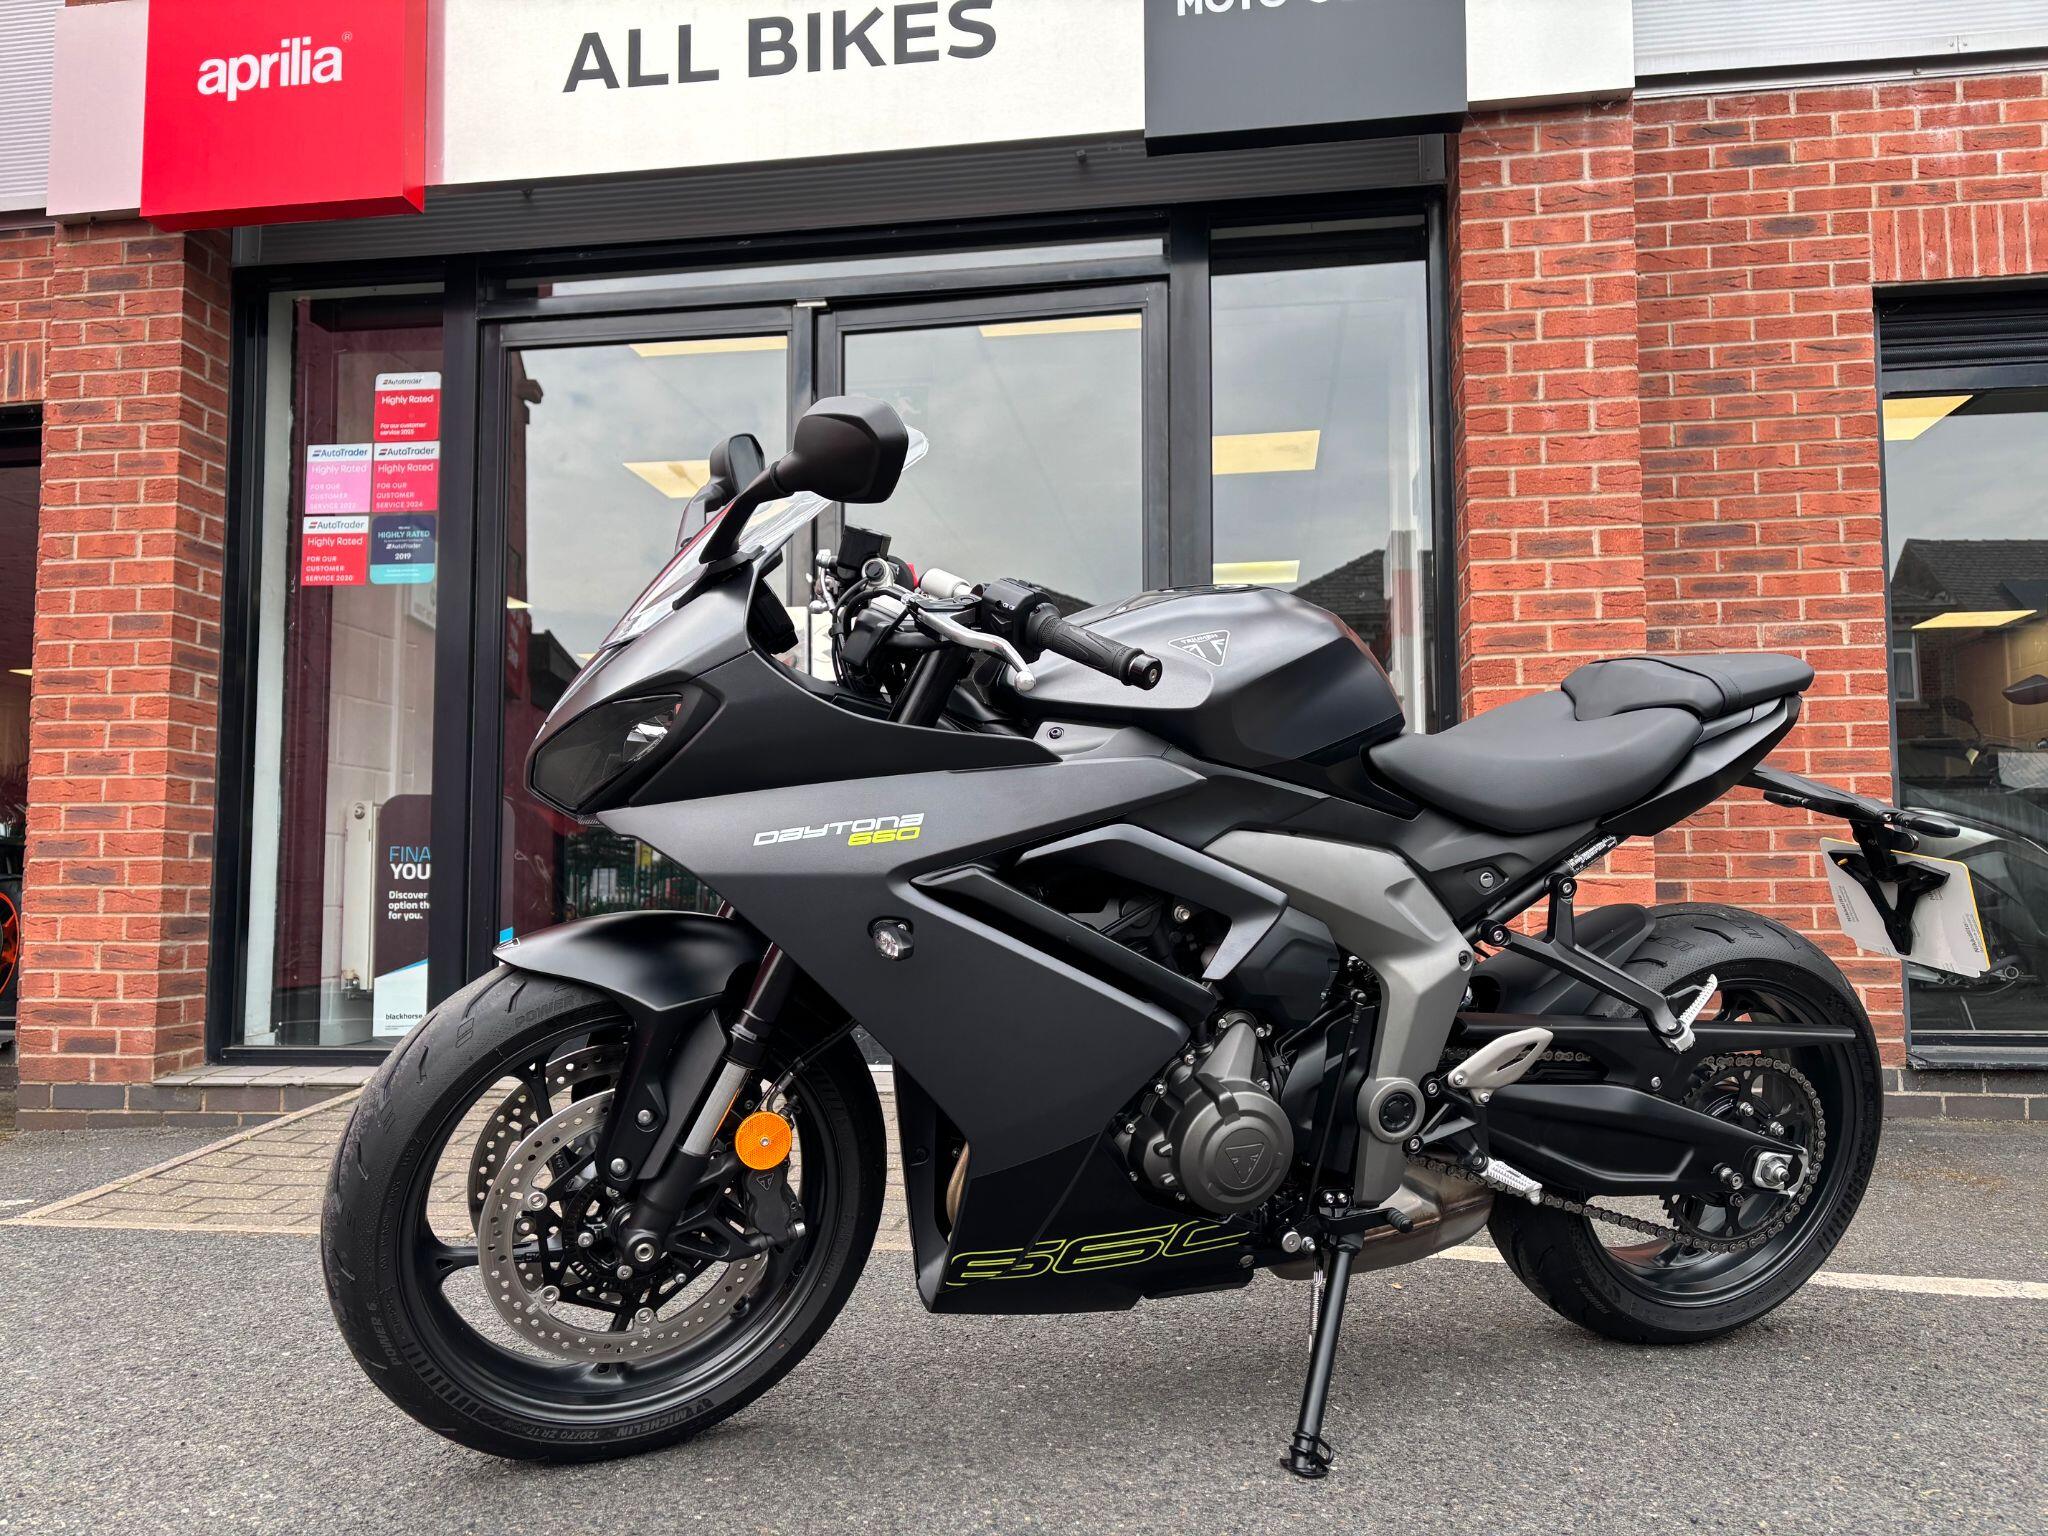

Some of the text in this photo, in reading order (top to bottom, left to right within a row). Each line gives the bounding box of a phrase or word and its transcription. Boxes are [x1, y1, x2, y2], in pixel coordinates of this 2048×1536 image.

[562, 0, 997, 93] ALL BIKES
[197, 36, 343, 102] aprilia
[381, 393, 434, 406] Highly Rated
[320, 448, 368, 457] AutoTrader
[387, 446, 435, 456] AutoTrader
[378, 462, 434, 475] Highly Rated
[392, 481, 408, 489] OUR
[376, 491, 415, 499] CUSTOMER
[317, 520, 365, 530] AutoTrader
[377, 529, 430, 539] HIGHLY RATED
[307, 535, 363, 547] Highly Rated
[321, 555, 337, 563] OUR
[394, 552, 412, 560] 2019
[305, 564, 345, 572] CUSTOMER
[305, 574, 334, 582] SERVICE
[848, 826, 921, 847] 660
[389, 846, 431, 862] FINA
[389, 863, 431, 880] YOU
[388, 890, 428, 899] Discover
[388, 900, 430, 911] option th
[388, 910, 423, 921] for you.
[616, 1407, 687, 1437] MICHELIN
